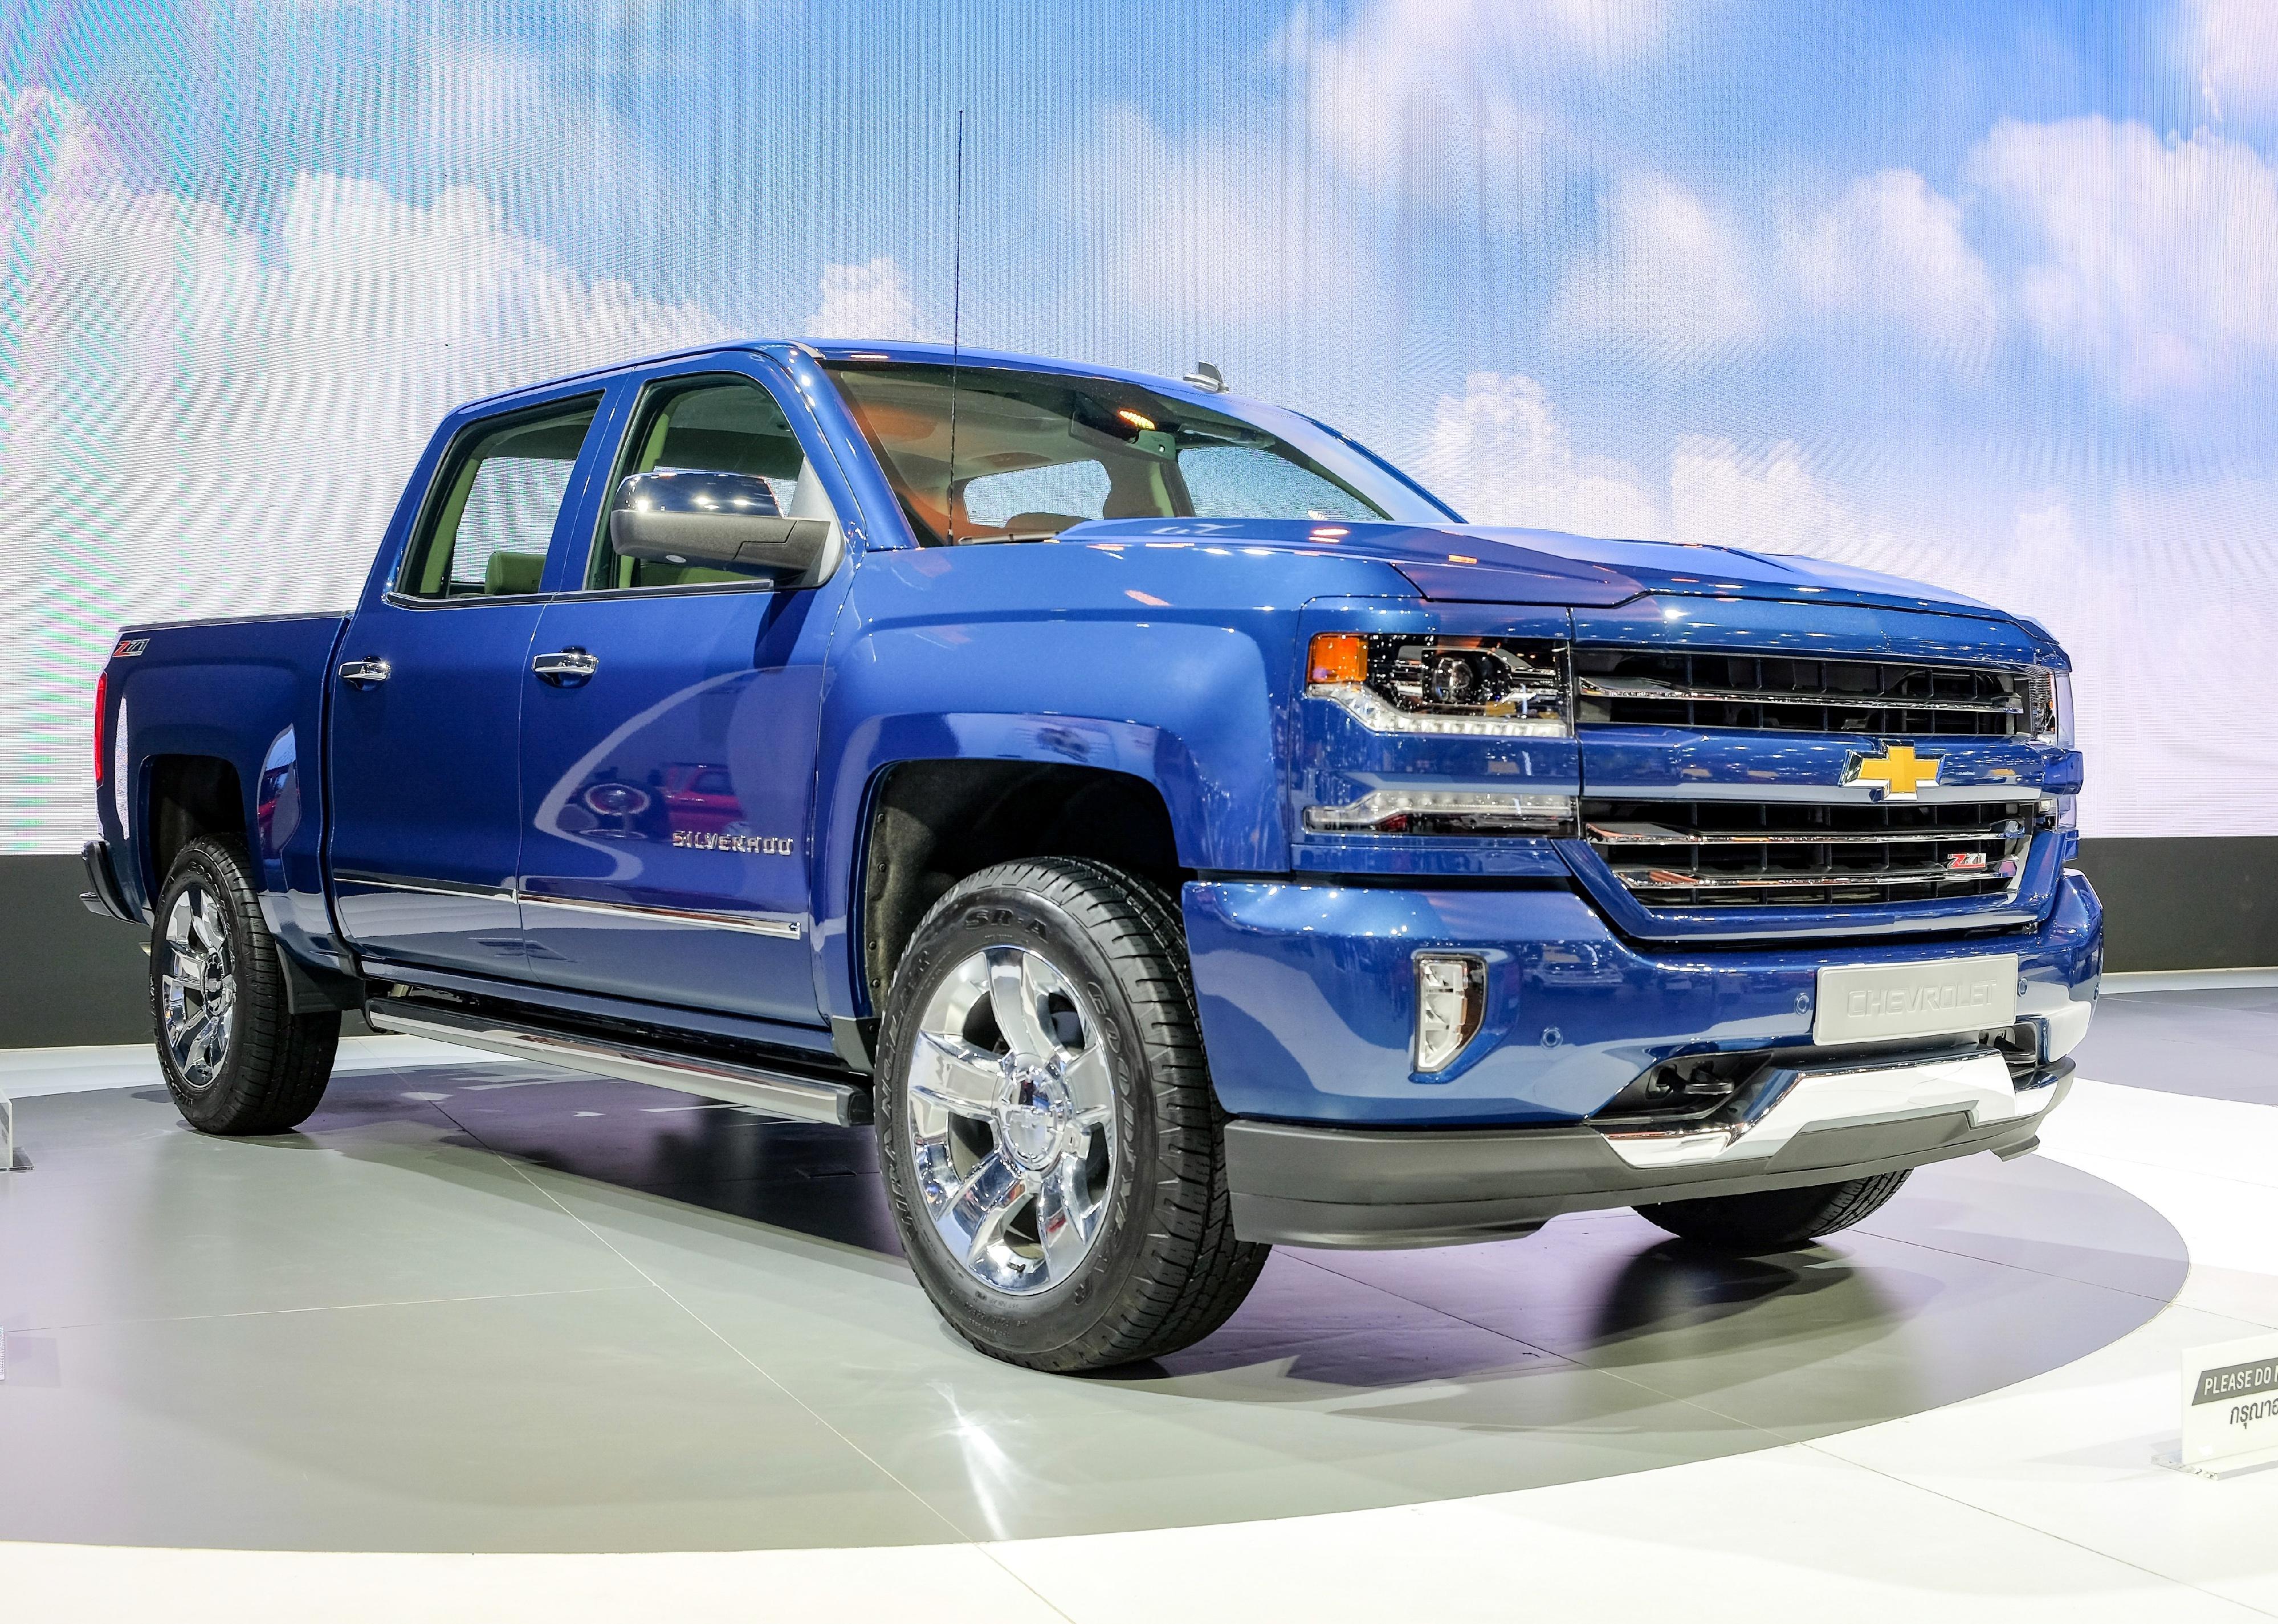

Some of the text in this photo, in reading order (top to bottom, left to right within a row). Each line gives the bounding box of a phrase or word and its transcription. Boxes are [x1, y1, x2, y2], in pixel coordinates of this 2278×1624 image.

[112, 638, 150, 657] Z71
[673, 830, 793, 856] SILVERADO
[1847, 980, 1997, 1018] CHEVROLET
[2204, 1370, 2253, 1396] PLEASE
[2255, 1366, 2272, 1386] DO
